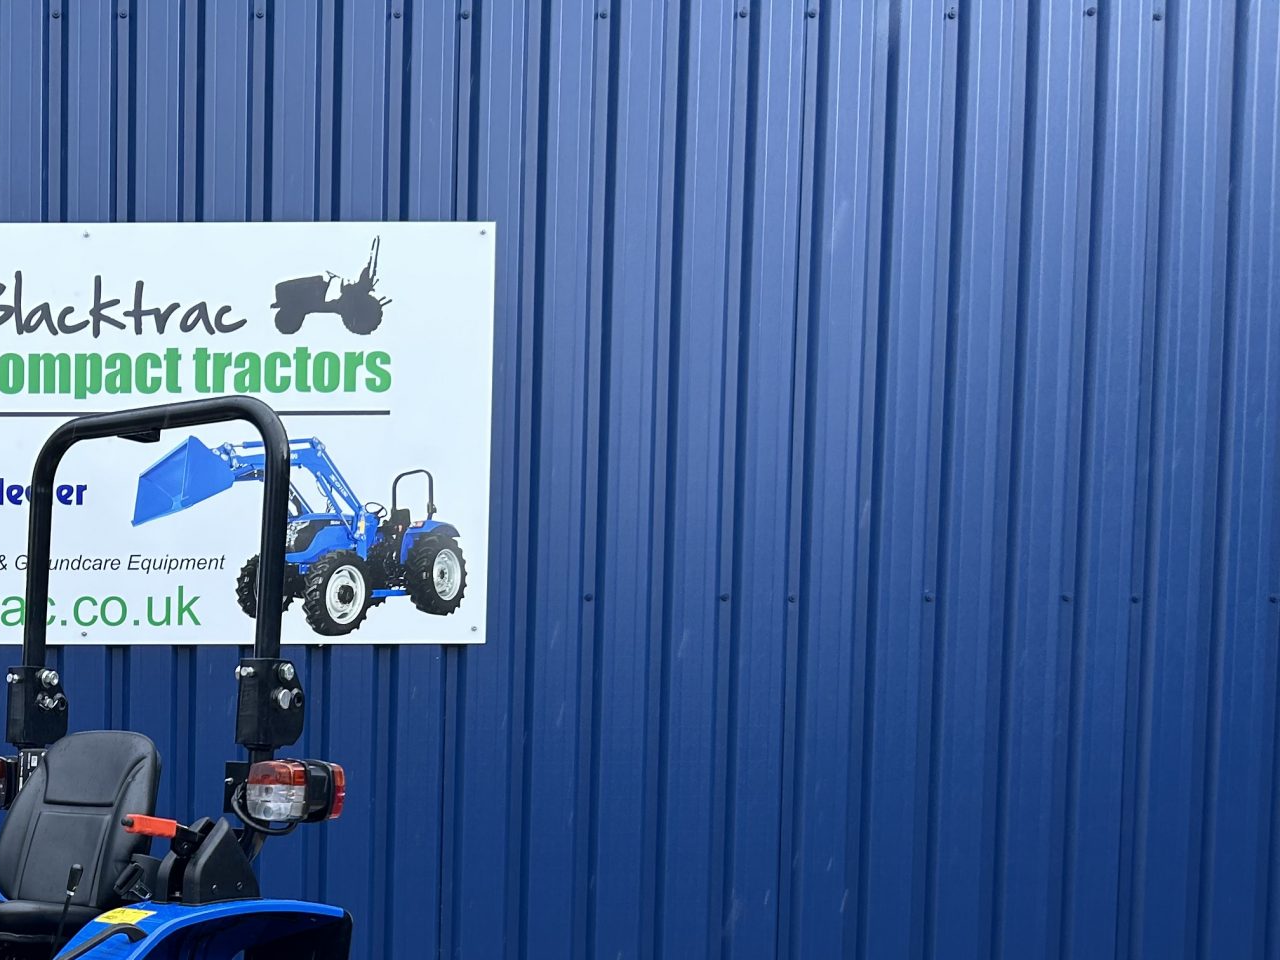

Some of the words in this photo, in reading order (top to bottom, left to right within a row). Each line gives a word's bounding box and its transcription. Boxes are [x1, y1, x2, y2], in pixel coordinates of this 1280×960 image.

[193, 346, 391, 393] tractors
[15, 555, 121, 570] Gundcare
[127, 555, 225, 574] Equipment
